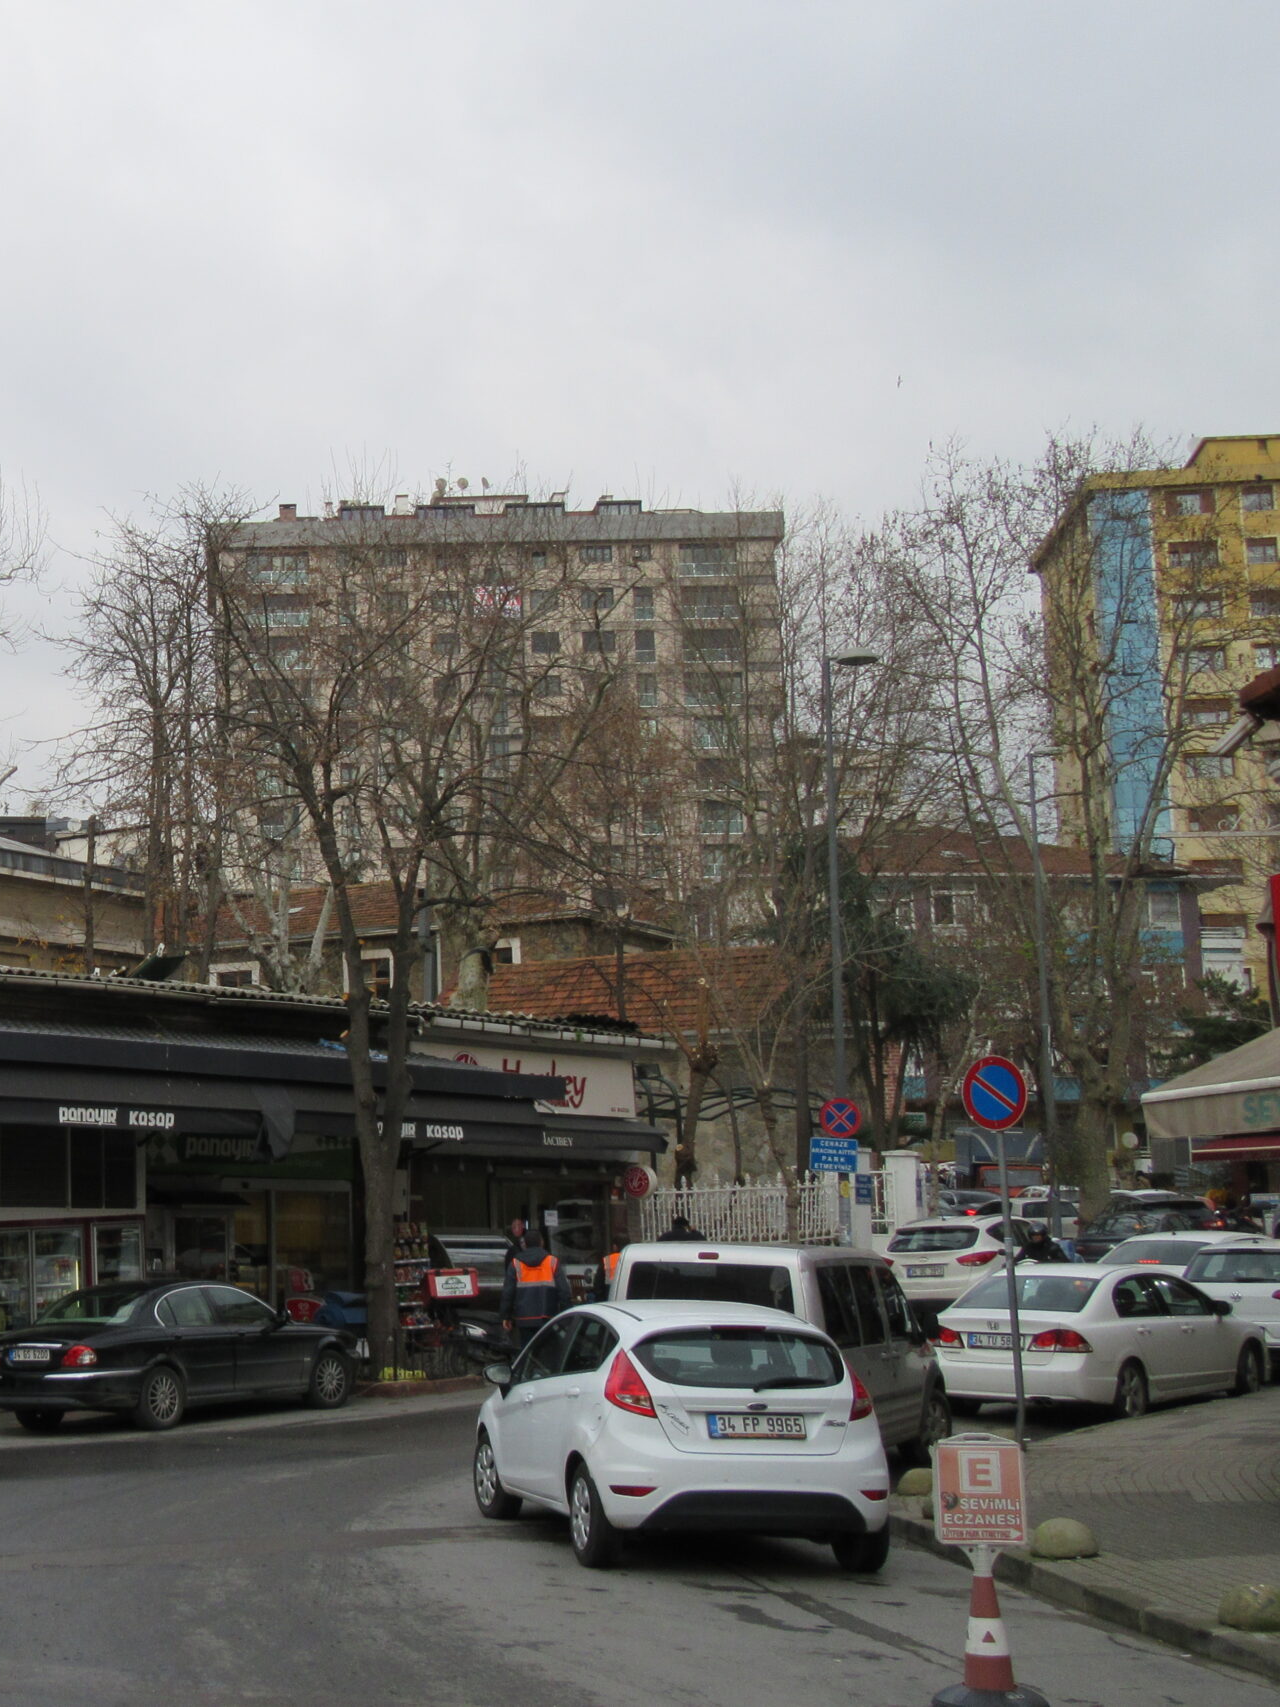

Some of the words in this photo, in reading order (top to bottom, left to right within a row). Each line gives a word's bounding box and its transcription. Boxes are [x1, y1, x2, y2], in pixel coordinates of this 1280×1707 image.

[973, 1333, 983, 1345] 34
[717, 1416, 736, 1432] 34
[742, 1417, 760, 1432] FP
[766, 1417, 803, 1433] 9965
[968, 1457, 992, 1487] E
